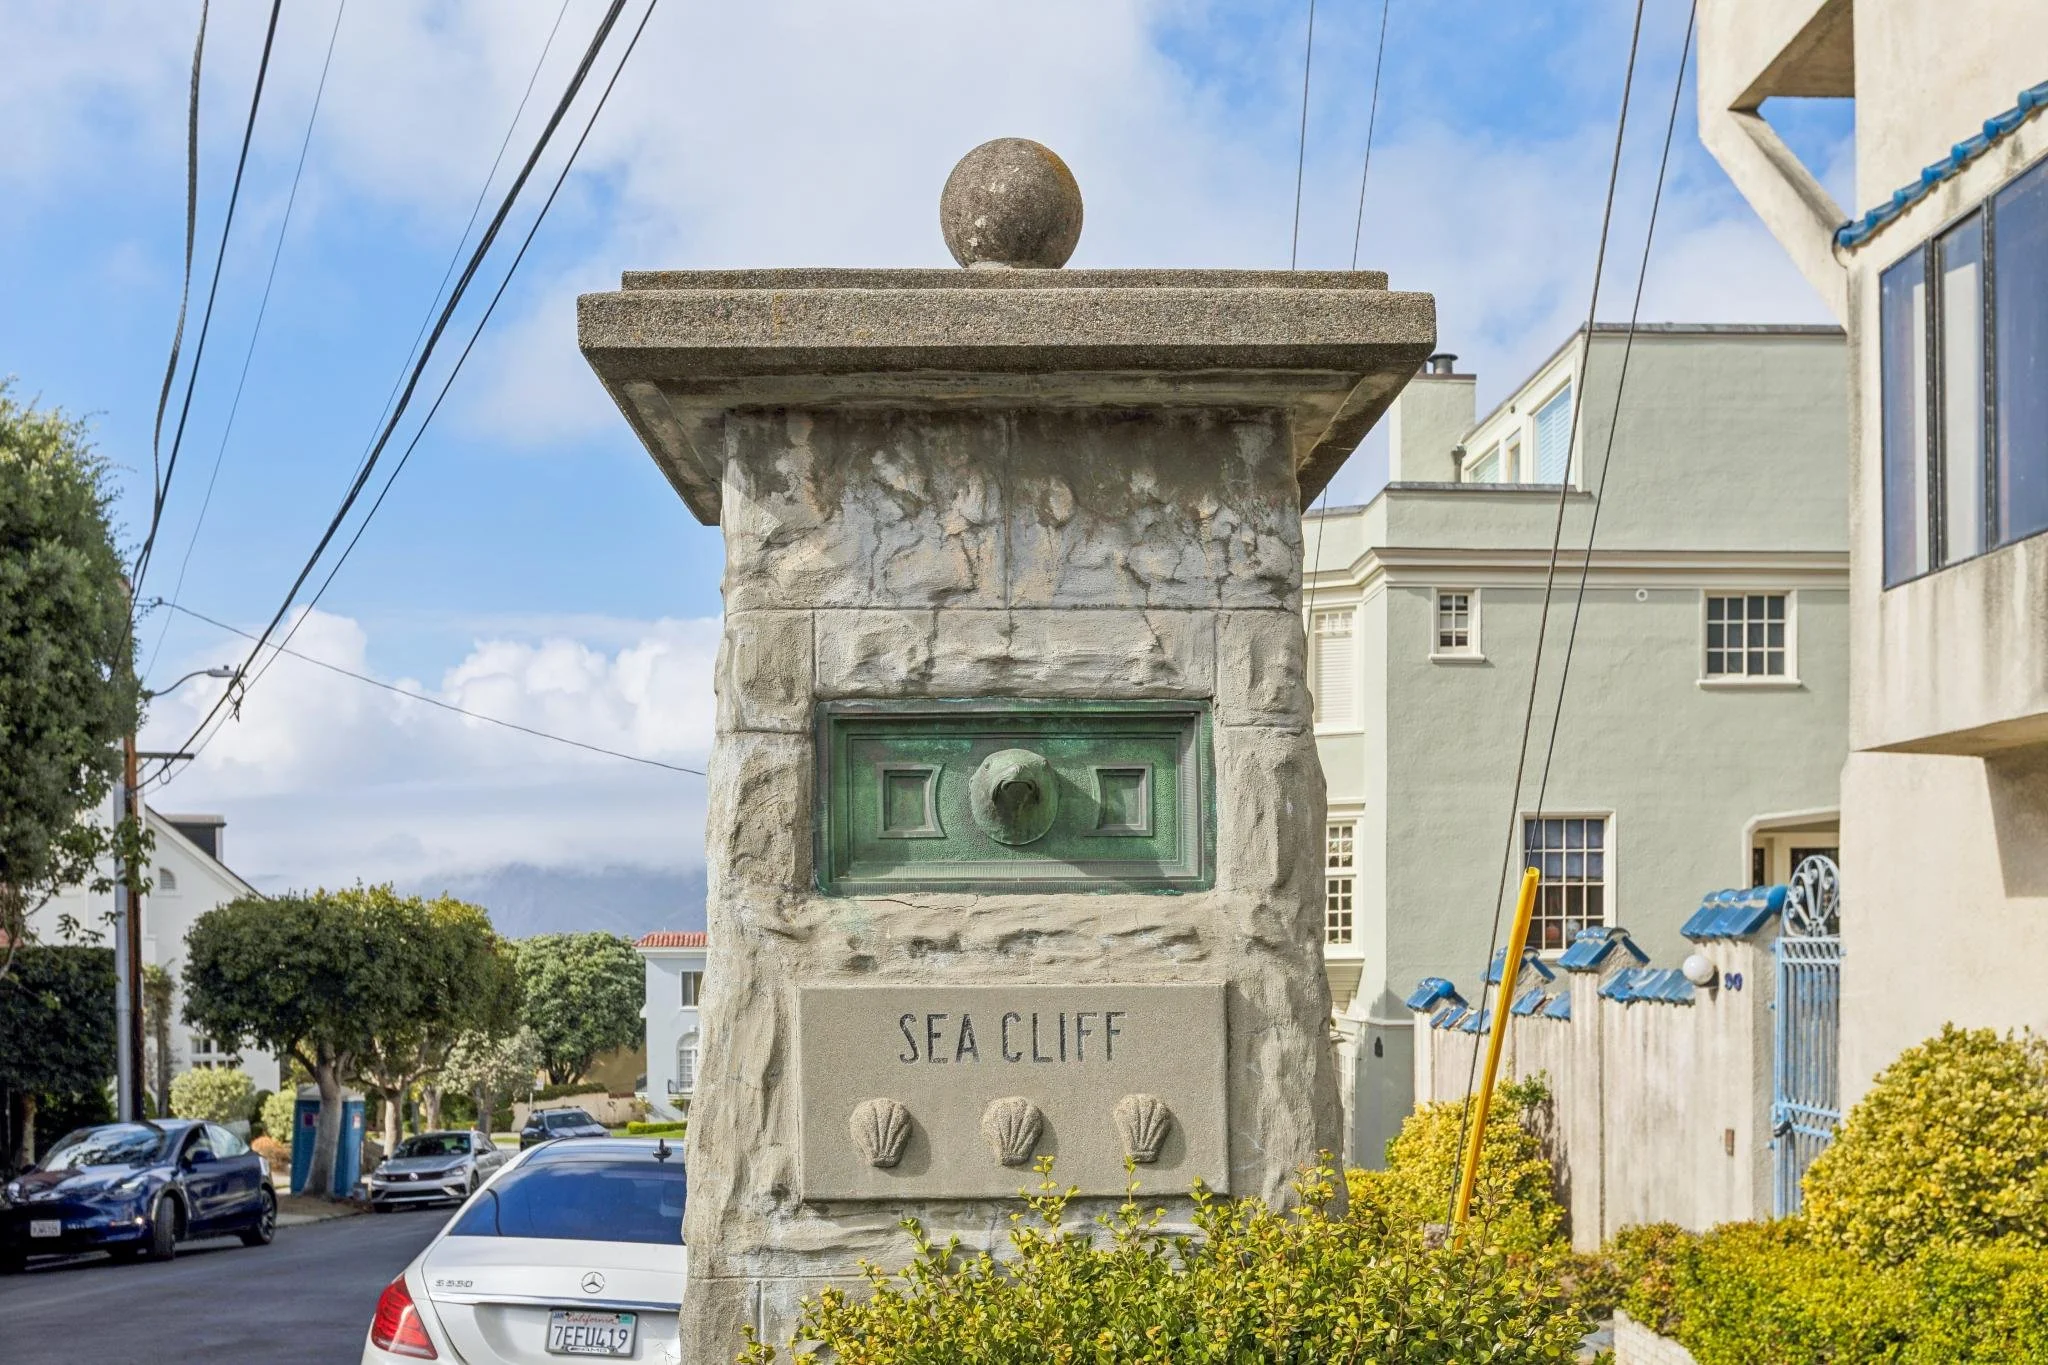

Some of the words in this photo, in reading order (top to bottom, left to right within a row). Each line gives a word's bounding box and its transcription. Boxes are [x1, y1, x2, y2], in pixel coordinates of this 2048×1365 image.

[899, 1012, 981, 1064] SEA
[1001, 1011, 1127, 1064] CLIFF
[554, 1325, 629, 1349] 7EFU419
